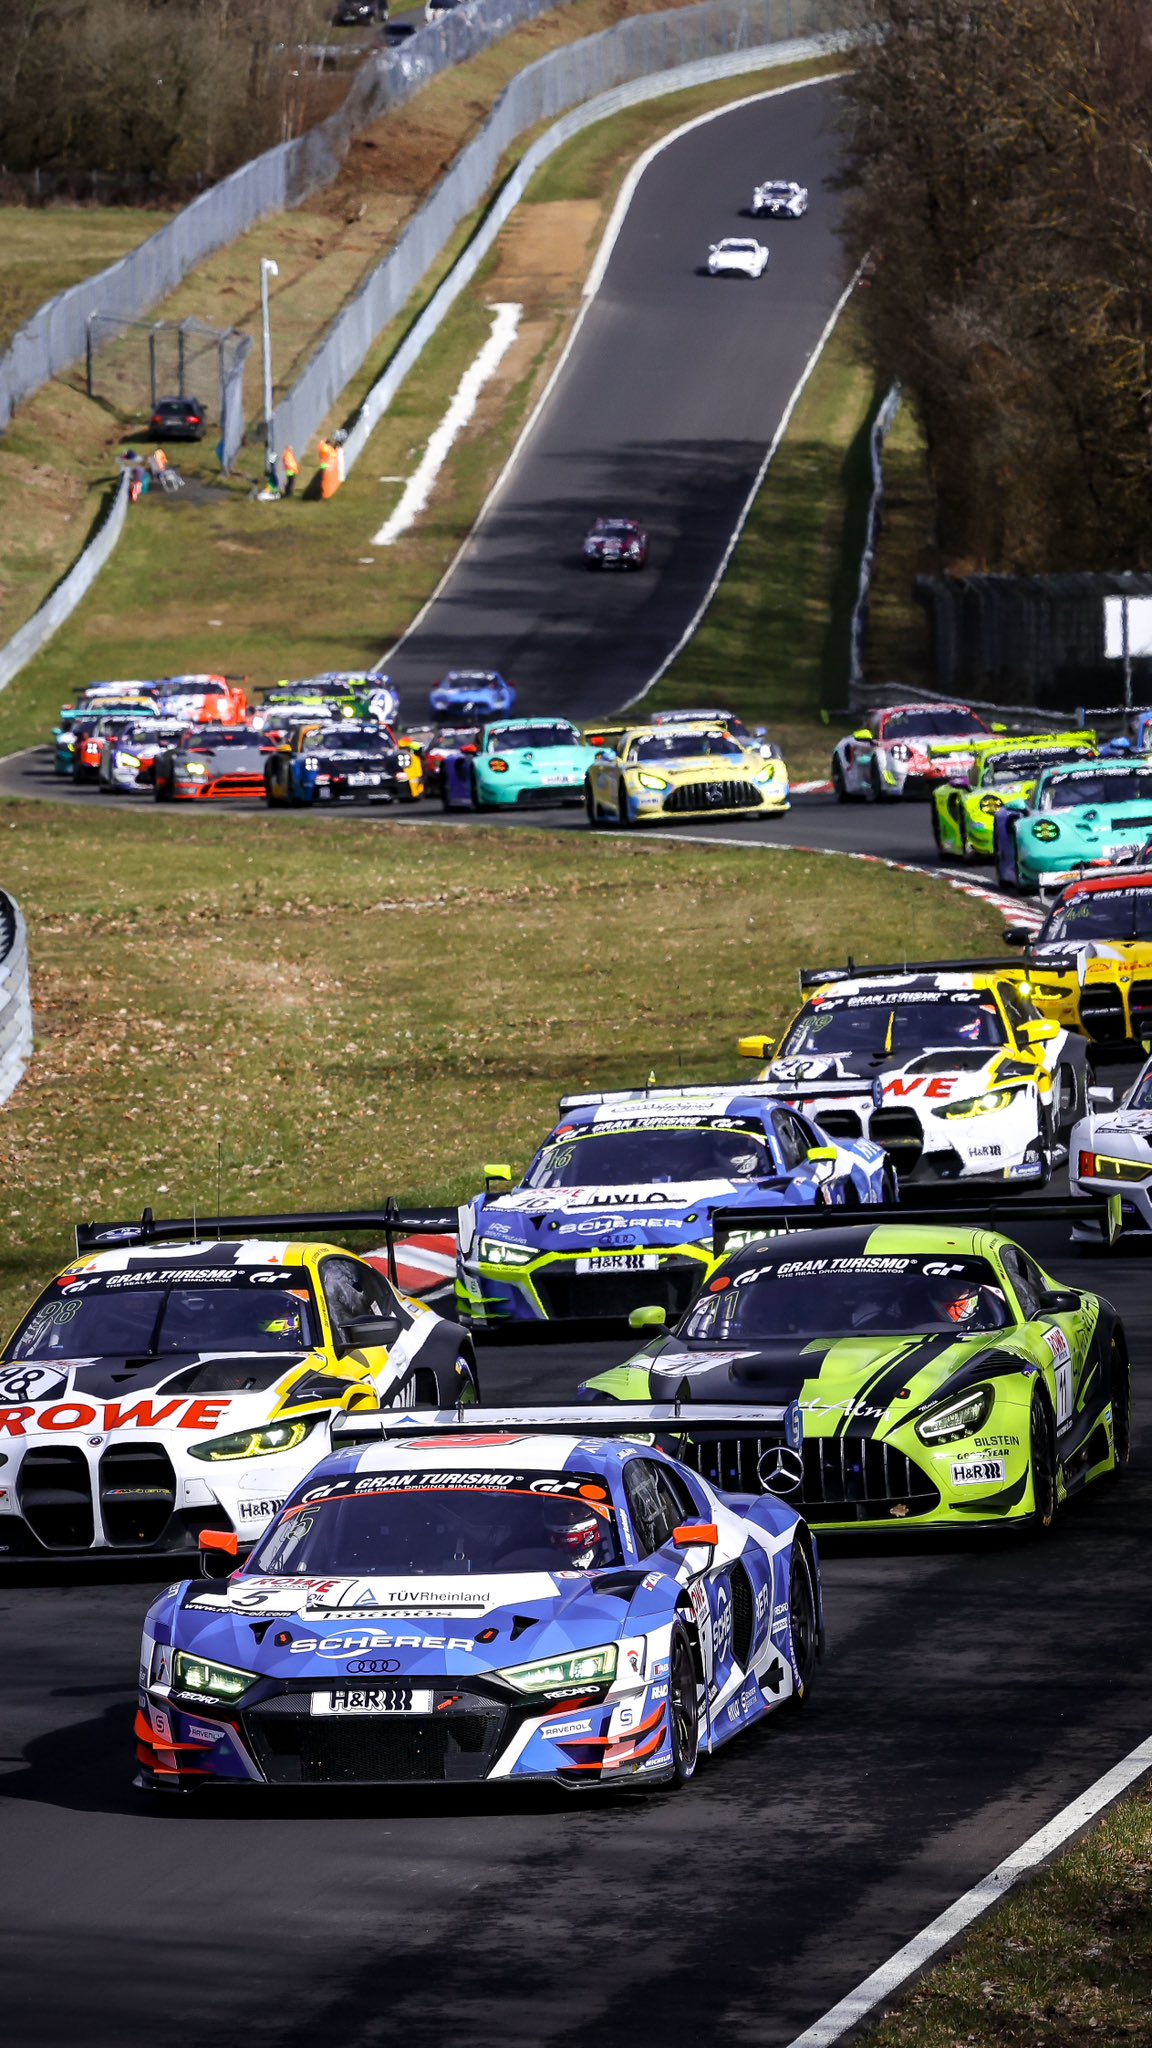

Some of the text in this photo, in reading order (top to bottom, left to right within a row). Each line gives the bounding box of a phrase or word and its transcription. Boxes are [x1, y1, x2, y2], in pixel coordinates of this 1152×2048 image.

[592, 1121, 632, 1133] GRAN
[544, 1145, 576, 1171] 16
[488, 1222, 512, 1233] IRS
[559, 1217, 683, 1234] SCHERER
[777, 1259, 829, 1274] GRAN
[106, 1271, 160, 1285] GRAN
[38, 1300, 83, 1325] 98
[0, 1399, 233, 1437] ROWE
[974, 1435, 1020, 1447] BILSTEIN
[953, 1465, 985, 1481] H&R
[355, 1475, 419, 1490] GRAN
[241, 1504, 270, 1518] H&R
[291, 1506, 321, 1540] 5
[250, 1578, 341, 1593] ROWE
[231, 1590, 280, 1607] 5
[184, 1603, 292, 1617] www.rowe-oil.com
[289, 1636, 475, 1654] SCHERER
[176, 1691, 220, 1704] RECARO
[543, 1685, 600, 1699] RECARO
[331, 1690, 382, 1711] H&R
[545, 1723, 588, 1736] RAVENOL
[645, 1754, 671, 1767] MICHELIN
